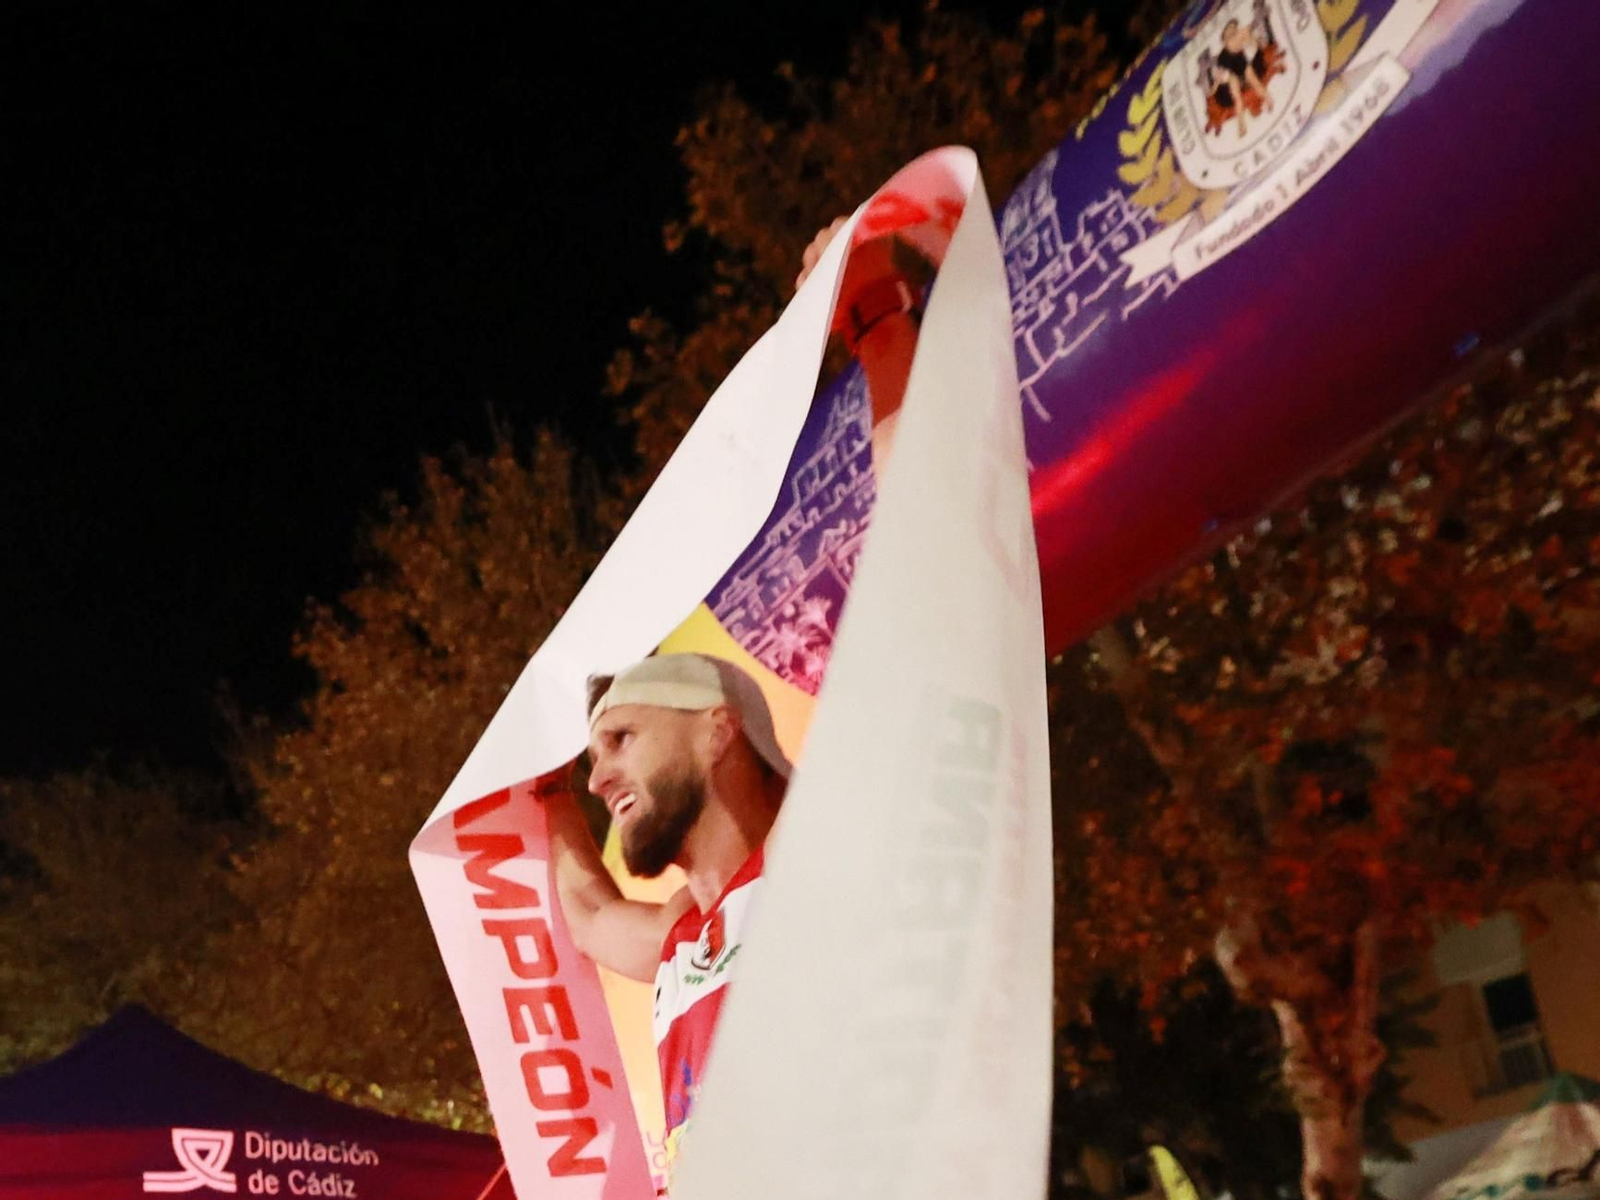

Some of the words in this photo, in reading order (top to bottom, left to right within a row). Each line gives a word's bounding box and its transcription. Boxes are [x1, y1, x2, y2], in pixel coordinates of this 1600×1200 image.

[245, 1131, 379, 1166] Diputación
[248, 1168, 279, 1195] de
[287, 1169, 357, 1199] Cádiz
